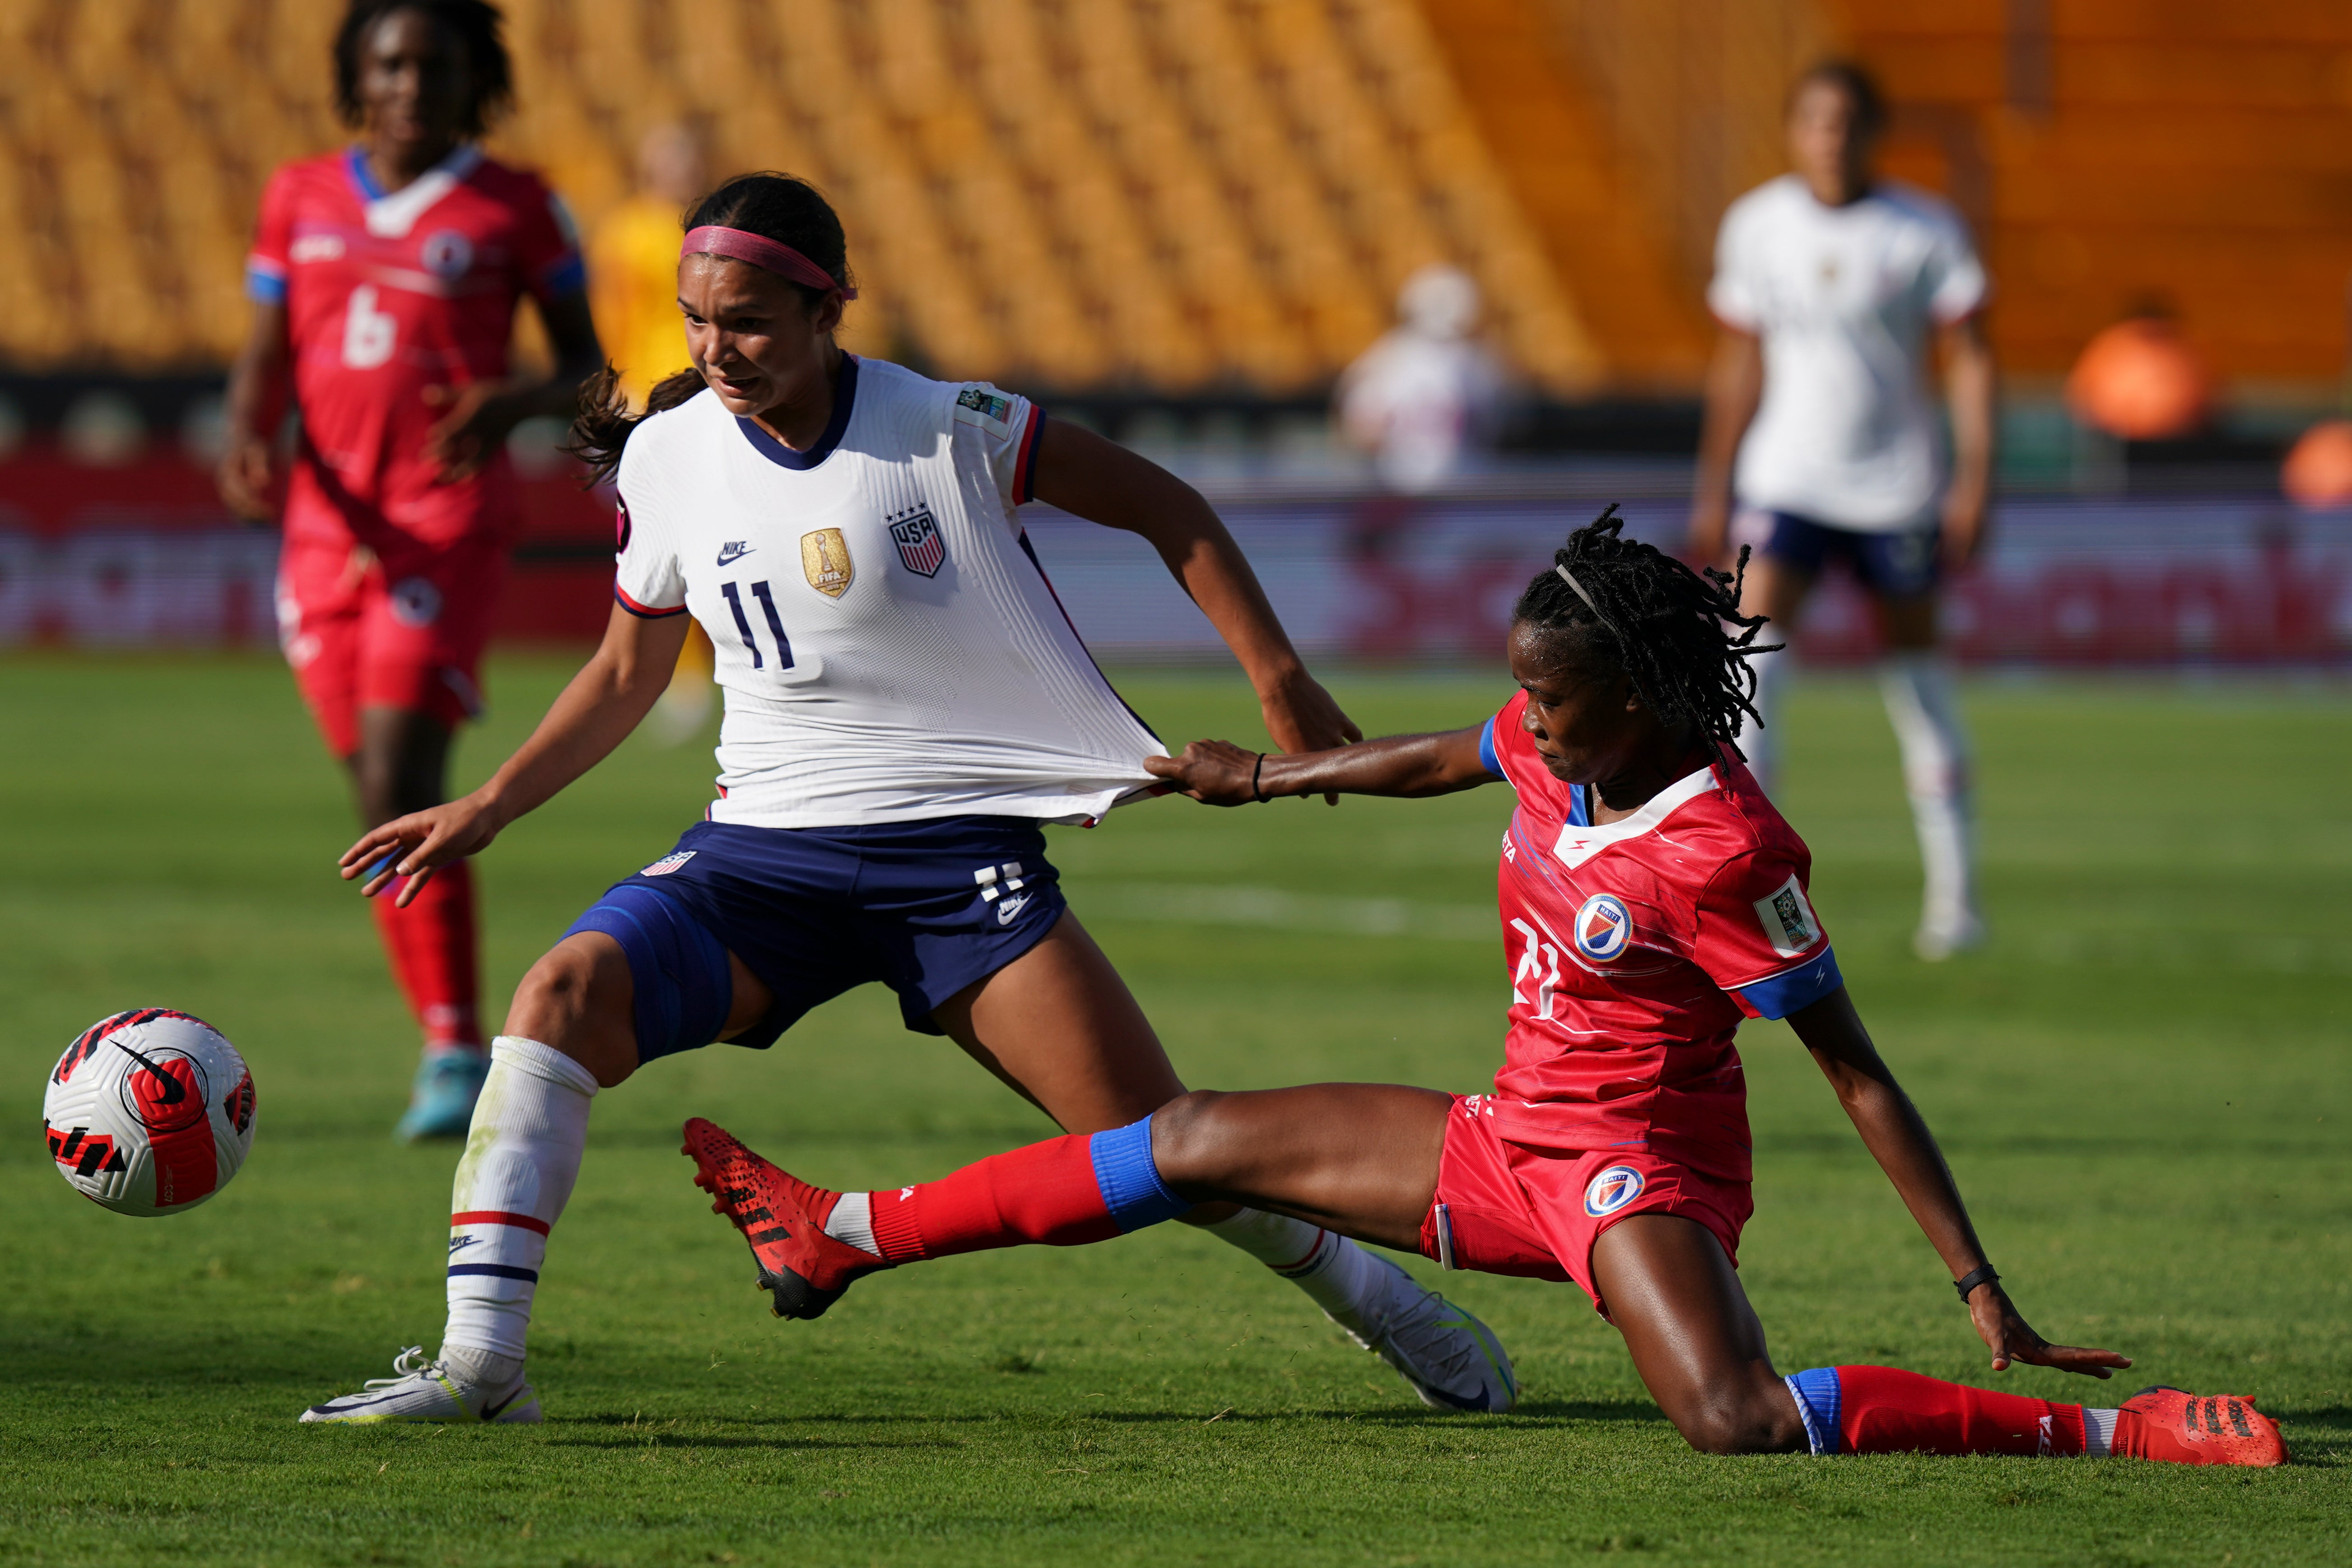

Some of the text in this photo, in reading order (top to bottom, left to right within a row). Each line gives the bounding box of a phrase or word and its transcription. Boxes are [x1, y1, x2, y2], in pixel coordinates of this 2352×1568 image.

[342, 283, 397, 370] 6
[895, 517, 931, 544] USA
[722, 541, 746, 555] NIKE
[819, 571, 841, 583] FIFA
[721, 580, 795, 670] 11
[999, 891, 1025, 914] NIKE
[1600, 905, 1618, 921] HAITI
[1509, 917, 1561, 1020] 21
